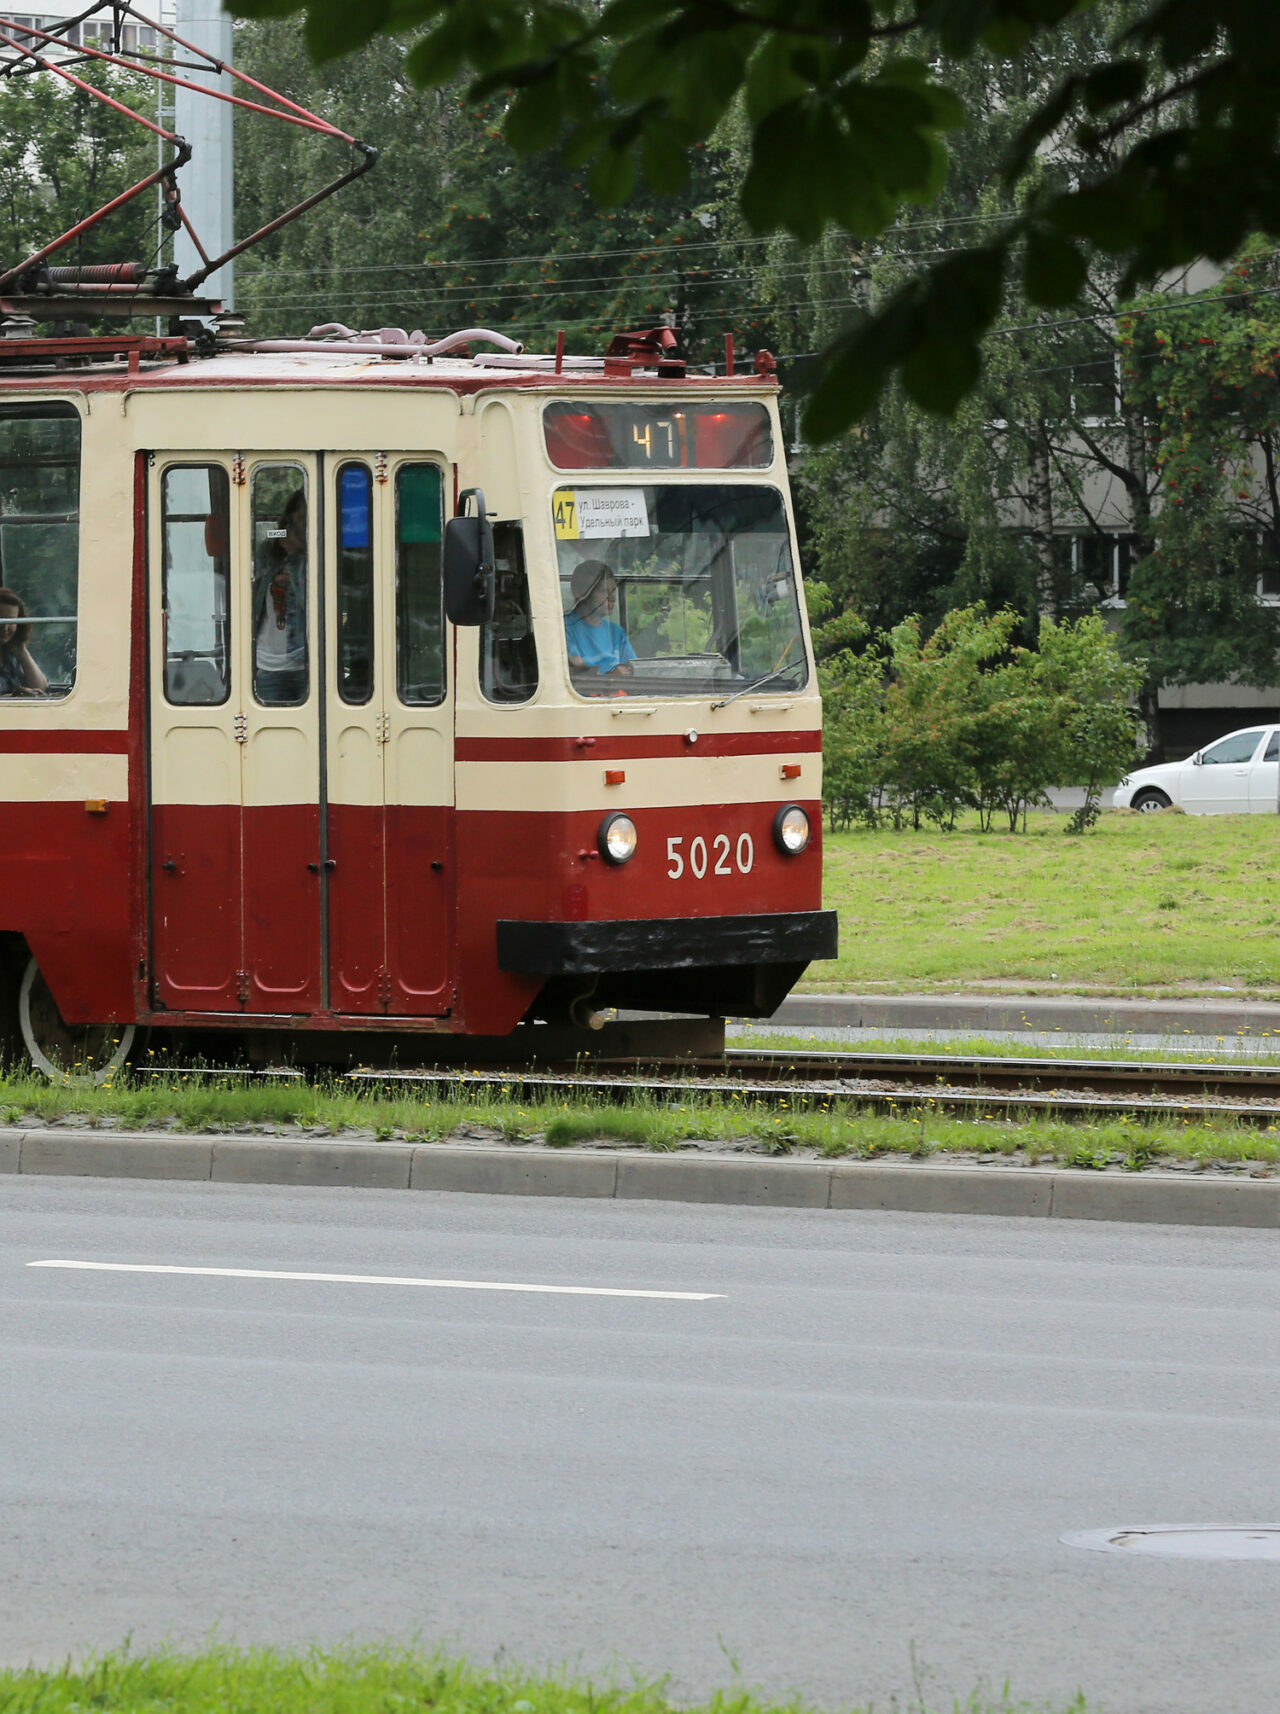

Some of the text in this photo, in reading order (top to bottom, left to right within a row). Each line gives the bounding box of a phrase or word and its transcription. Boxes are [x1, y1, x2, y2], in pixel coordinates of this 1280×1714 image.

[633, 421, 673, 459] 47
[555, 501, 575, 529] 47
[592, 498, 630, 512] Шаврова
[580, 515, 644, 529] Удельный парк
[666, 832, 754, 880] 5020
